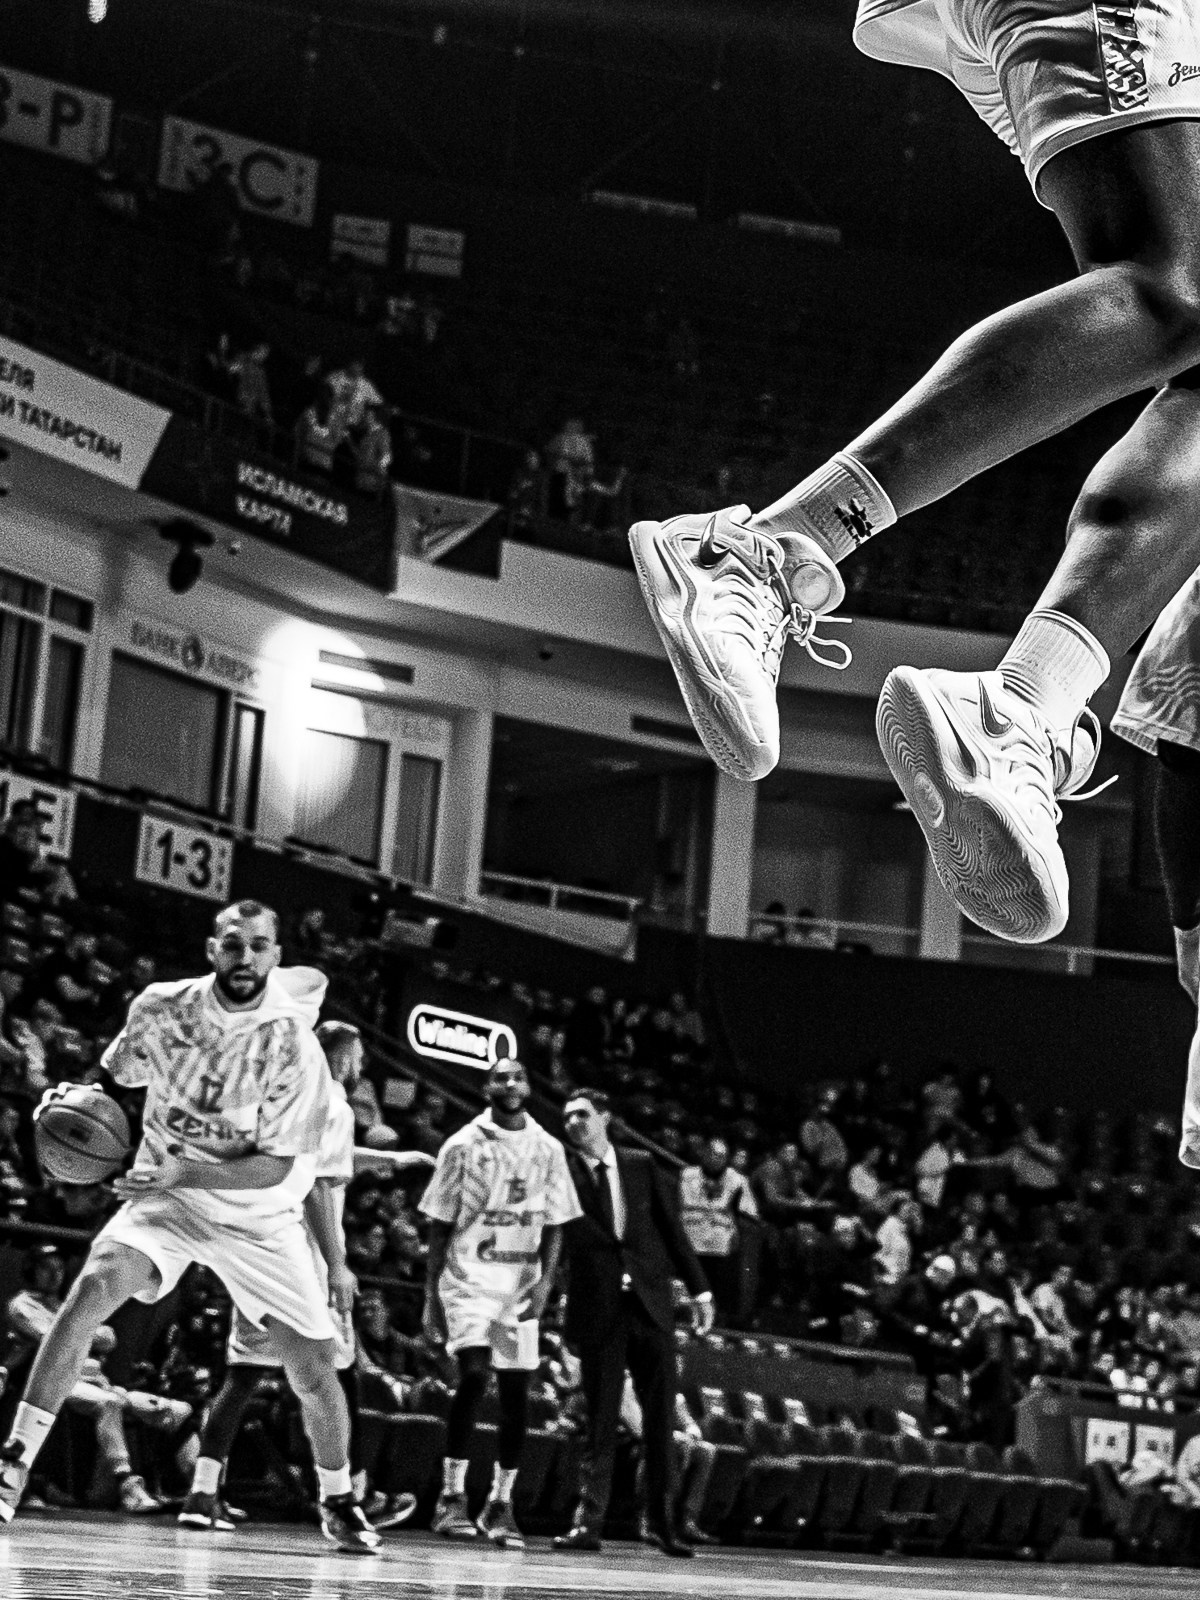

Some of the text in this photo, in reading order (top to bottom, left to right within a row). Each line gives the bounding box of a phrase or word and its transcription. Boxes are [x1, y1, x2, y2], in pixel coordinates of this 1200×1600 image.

[19, 400, 123, 462] ТАТАРСТАН
[235, 494, 293, 537] КАРТА
[418, 1015, 489, 1058] Winline
